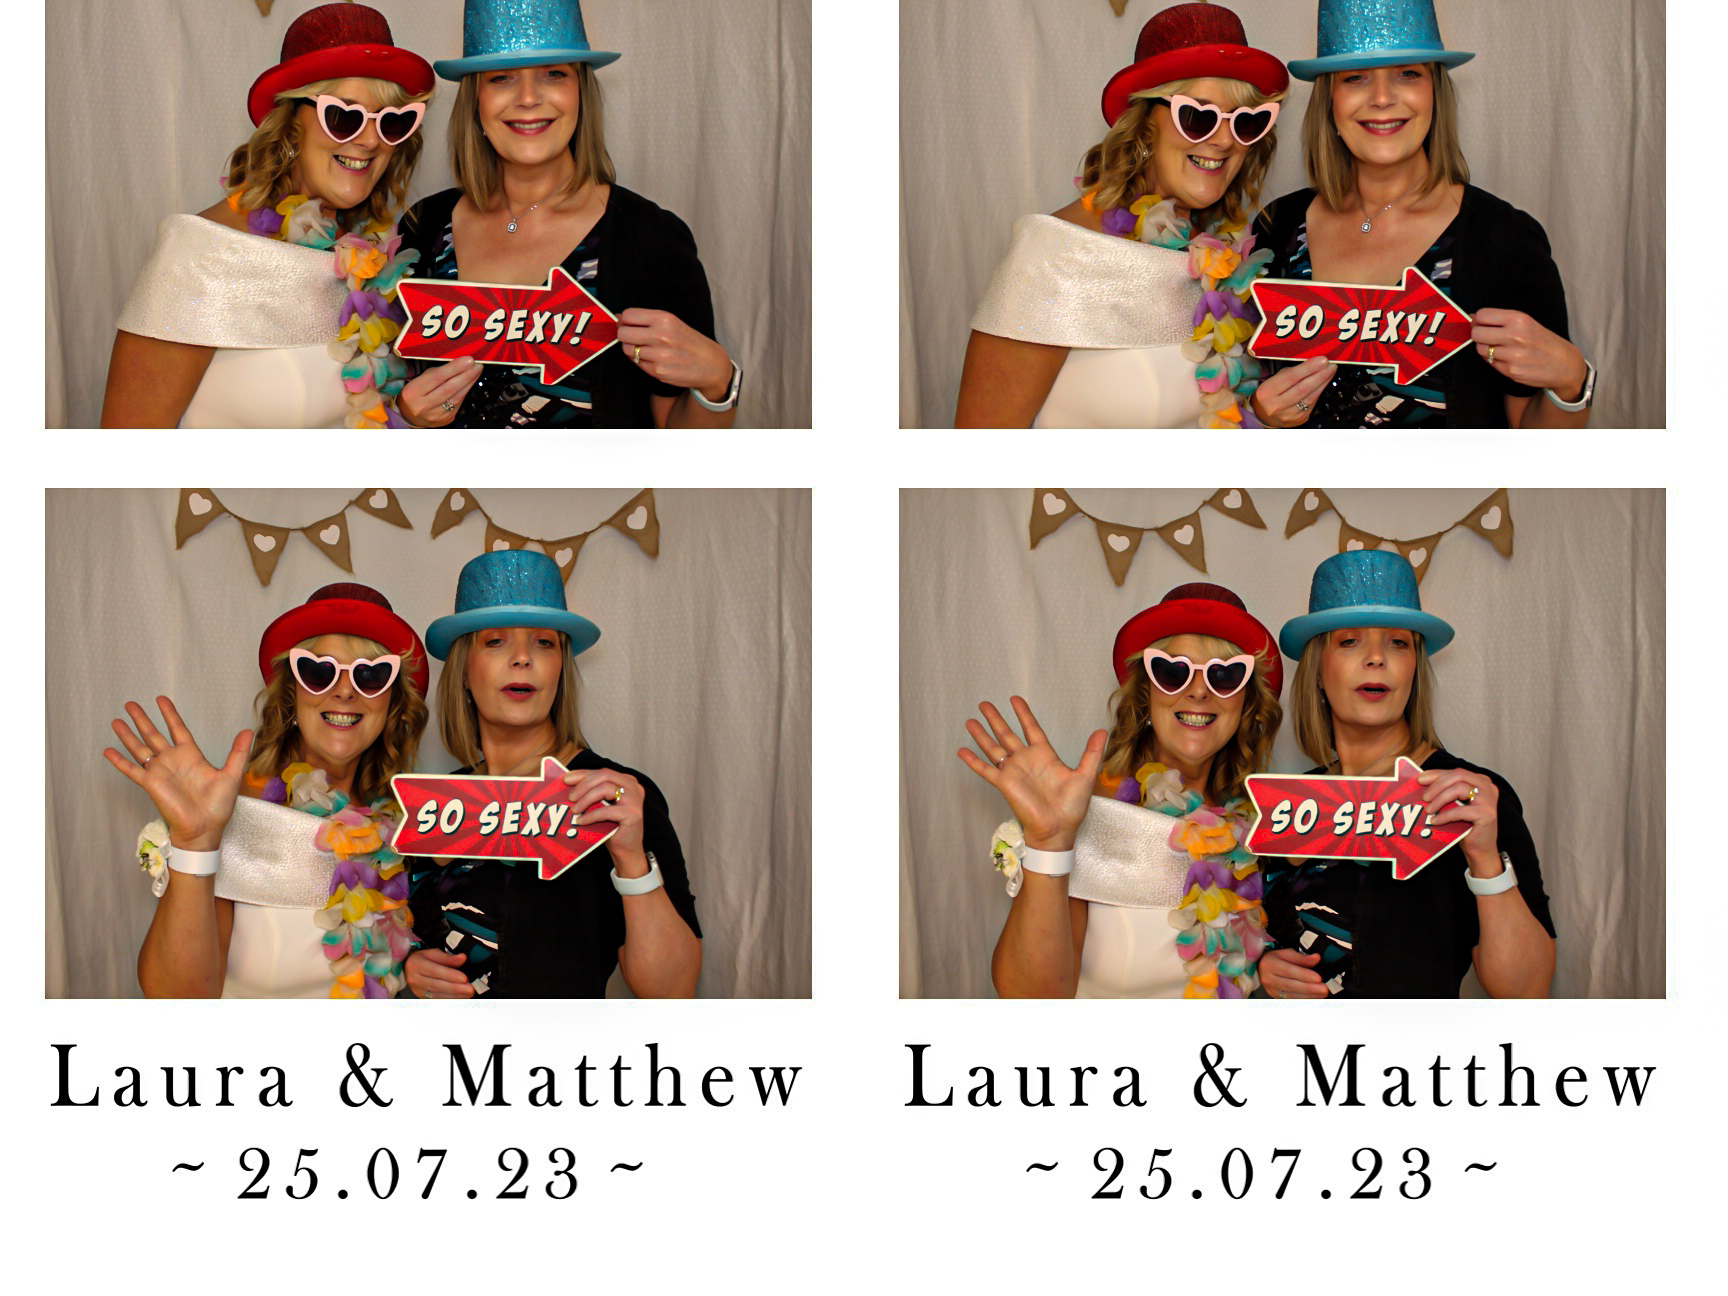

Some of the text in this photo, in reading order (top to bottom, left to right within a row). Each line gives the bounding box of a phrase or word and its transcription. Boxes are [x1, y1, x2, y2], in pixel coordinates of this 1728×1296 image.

[421, 304, 593, 346] SO SEXY!
[1275, 304, 1447, 346] SO SEXY!
[416, 798, 465, 834] SO
[1270, 798, 1319, 834] SO
